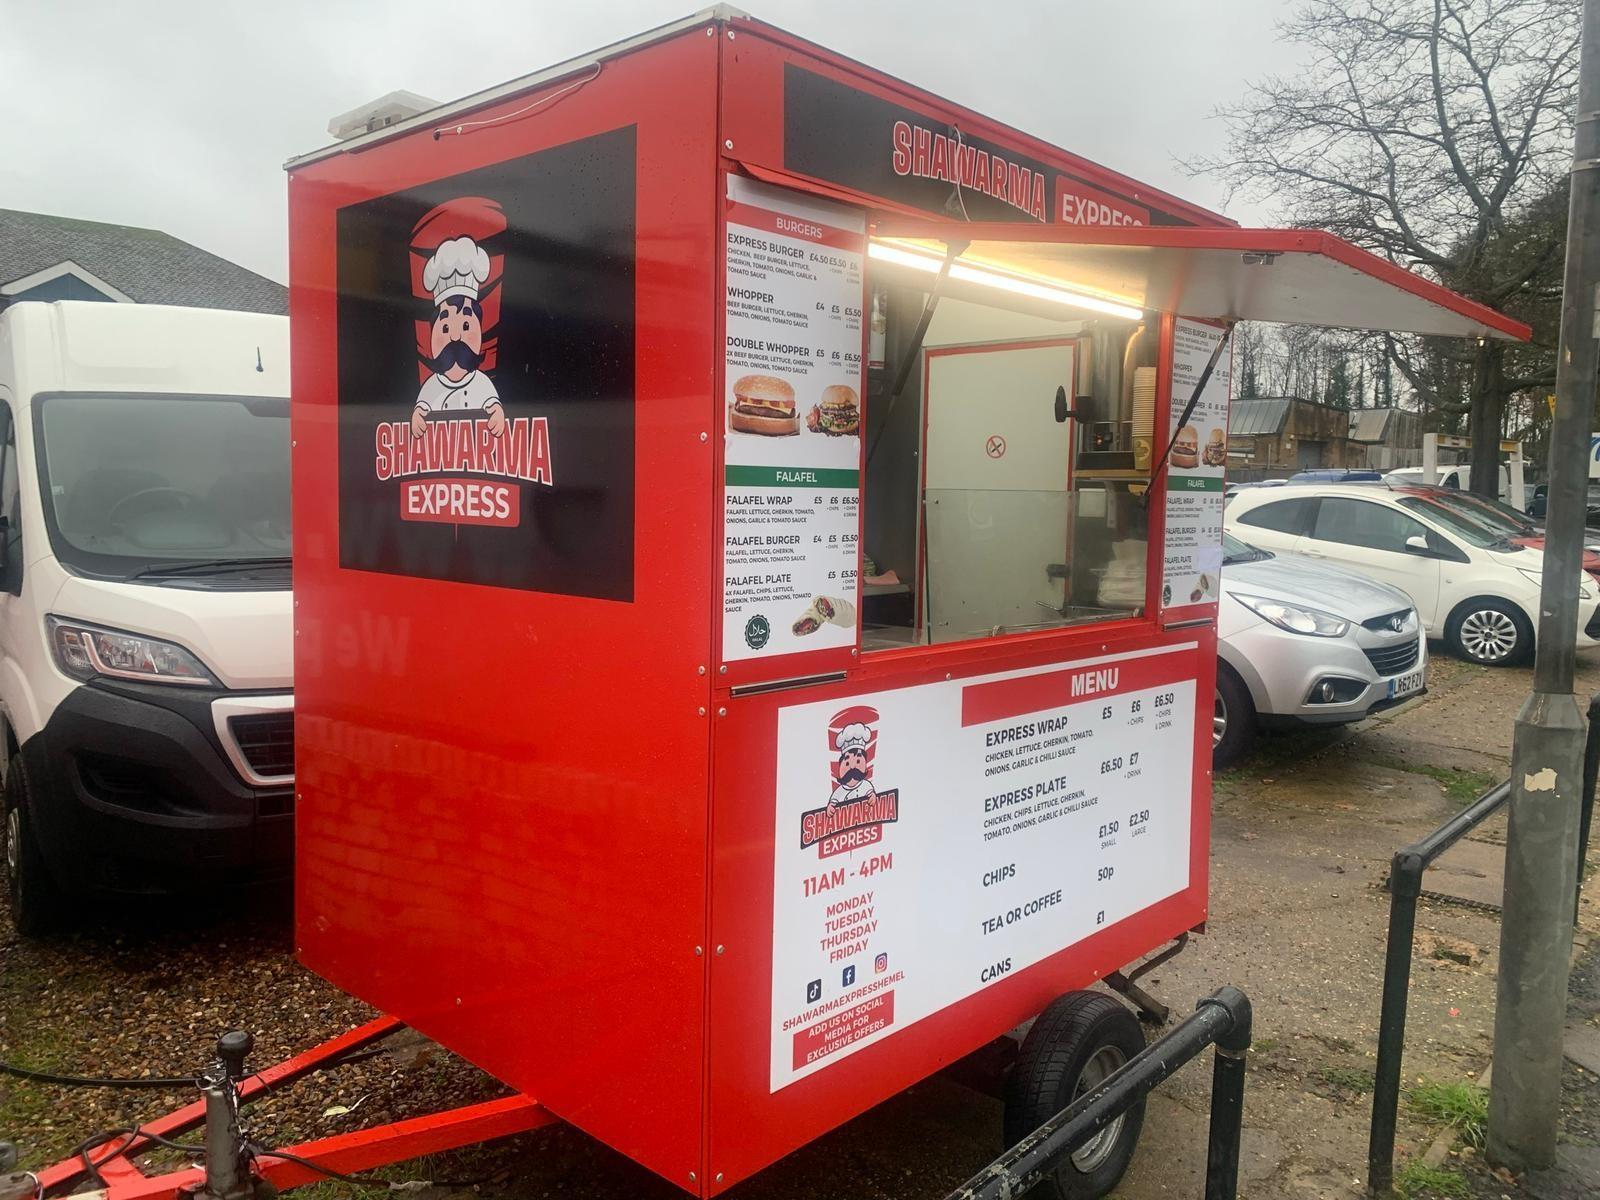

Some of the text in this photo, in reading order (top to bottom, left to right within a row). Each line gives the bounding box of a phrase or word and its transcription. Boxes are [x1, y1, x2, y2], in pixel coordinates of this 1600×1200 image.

[893, 121, 1046, 222] SHAWARMA
[1062, 194, 1143, 225] EXPRE
[776, 217, 822, 239] BURGERS
[728, 233, 767, 251] EXPRESS
[770, 242, 804, 259] BURGER
[809, 253, 828, 264] £4.50
[829, 257, 846, 267] £5.50
[728, 266, 766, 279] TOMATO SAUCE
[728, 287, 861, 317] WHOPPER £4 £5 £5.50
[727, 336, 764, 350] DOUBLE
[766, 342, 809, 357] WHOPPER
[816, 349, 824, 357] £5
[845, 354, 861, 362] £6.50
[376, 417, 553, 486] SHAWARMA
[776, 472, 817, 482] FALAFEL
[408, 484, 510, 519] EXPRESS
[726, 496, 764, 504] FALAFEL
[767, 496, 792, 504] WRAP
[830, 496, 838, 504] £6
[726, 537, 764, 546] FALAFEL
[766, 536, 800, 544] BURGER
[842, 534, 858, 542] £5.50
[726, 570, 857, 586] FALAFEL PLATE £5 £5.50
[1071, 668, 1119, 697] MENU
[1102, 693, 1174, 720] £5 £6 £6.50
[986, 716, 1068, 747] EXPRESS WRAP
[1131, 716, 1144, 726] CHIPS
[985, 729, 1093, 763] CHICKEN, LETTUCE, GHERKIN, TOMATO,
[985, 746, 1076, 777] ONIONS, GARLIC & CHILLI SAUCE
[1101, 752, 1139, 774] £6.50 £7
[1127, 768, 1142, 779] DRINK
[984, 776, 1066, 813] EXPRESS PLATE
[802, 793, 897, 844] SHAWARMA
[983, 797, 1098, 842] TOMATO, ONIONS, GARLIC & CHILLI SAUCE
[984, 789, 1085, 829] CHICKEN, CHIPS, LETTUCE, GHERKIN,
[1099, 809, 1149, 839] £1.50 £2.50
[1131, 826, 1146, 837] LARGE
[823, 826, 878, 854] EXPRESS
[1101, 839, 1116, 849] SMALL
[803, 868, 845, 897] 11AM
[860, 853, 893, 878] 4PM
[983, 864, 1016, 887] CHIPS
[1098, 866, 1114, 881] 50p
[827, 891, 873, 918] MONDAY
[982, 890, 1062, 935] TEA OR COFFEE
[1097, 911, 1105, 925] £1
[825, 906, 874, 934] TUESDAY
[820, 920, 878, 951] THURSDAY
[830, 938, 868, 963] FRIDAY
[981, 958, 1011, 983] CANS
[783, 971, 905, 1032] SHAWARMAEXPRESSHEMEL
[809, 997, 884, 1038] ADD US ON SOCIAL
[825, 1015, 869, 1042] MEDIA FOR
[807, 1019, 884, 1063] EXCLUSIVE OFFERS
